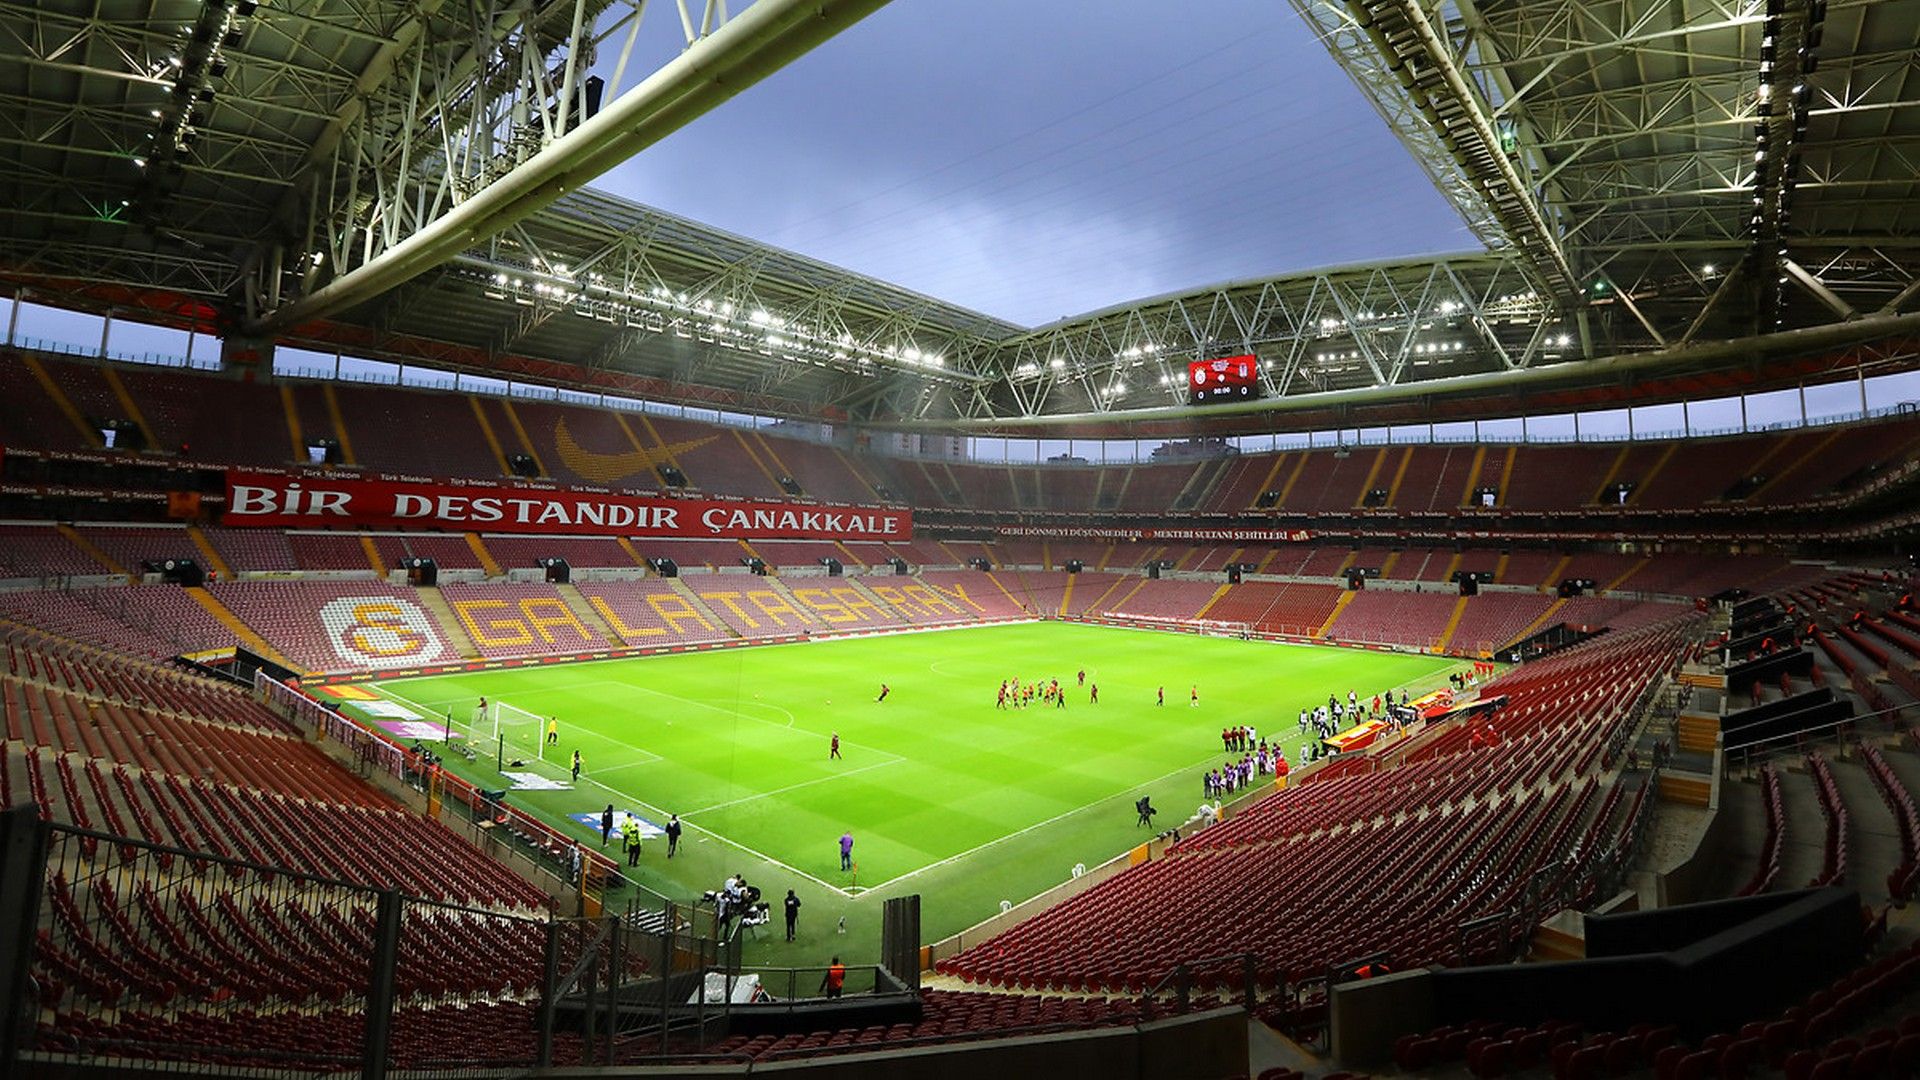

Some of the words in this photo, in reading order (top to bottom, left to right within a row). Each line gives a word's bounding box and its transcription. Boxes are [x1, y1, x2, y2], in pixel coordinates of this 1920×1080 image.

[324, 471, 360, 480] Telekom
[230, 483, 352, 516] BİR
[391, 493, 679, 529] DESTANDIR
[702, 508, 898, 534] ÇANAKKALE
[1000, 526, 1024, 536] GERİ
[1153, 529, 1194, 539] MEKTEBİ
[1234, 529, 1288, 540] ŞEHİTLERİ
[452, 583, 986, 648] GALATASARAY
